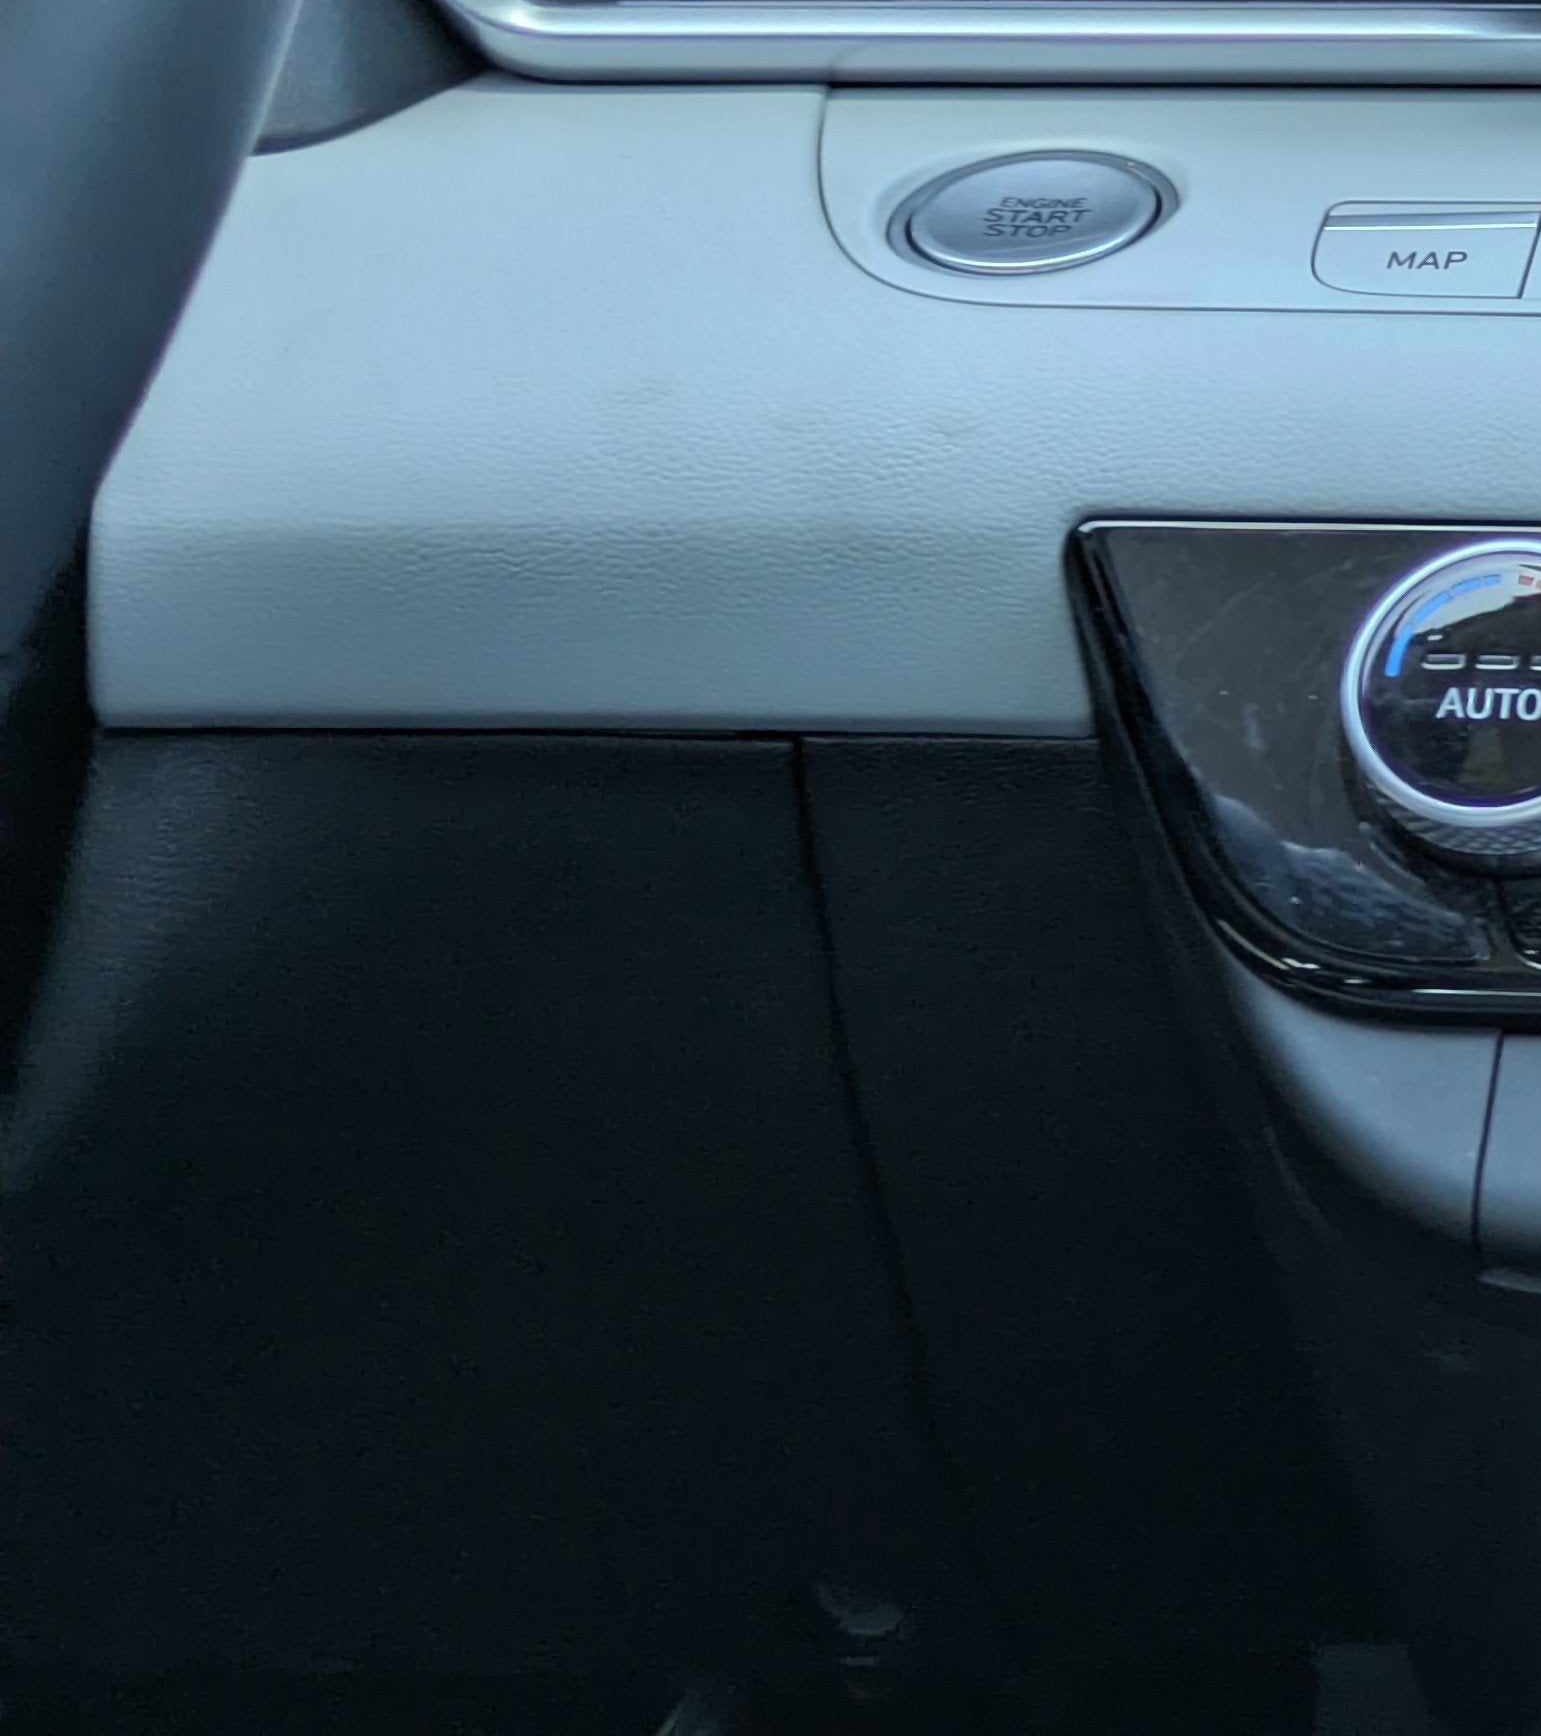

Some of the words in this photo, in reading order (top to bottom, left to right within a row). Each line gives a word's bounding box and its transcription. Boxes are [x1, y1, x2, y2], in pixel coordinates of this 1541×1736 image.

[999, 196, 1090, 209] ENGINE
[983, 209, 1091, 224] START
[983, 224, 1072, 238] STOP
[1386, 250, 1468, 270] MAP
